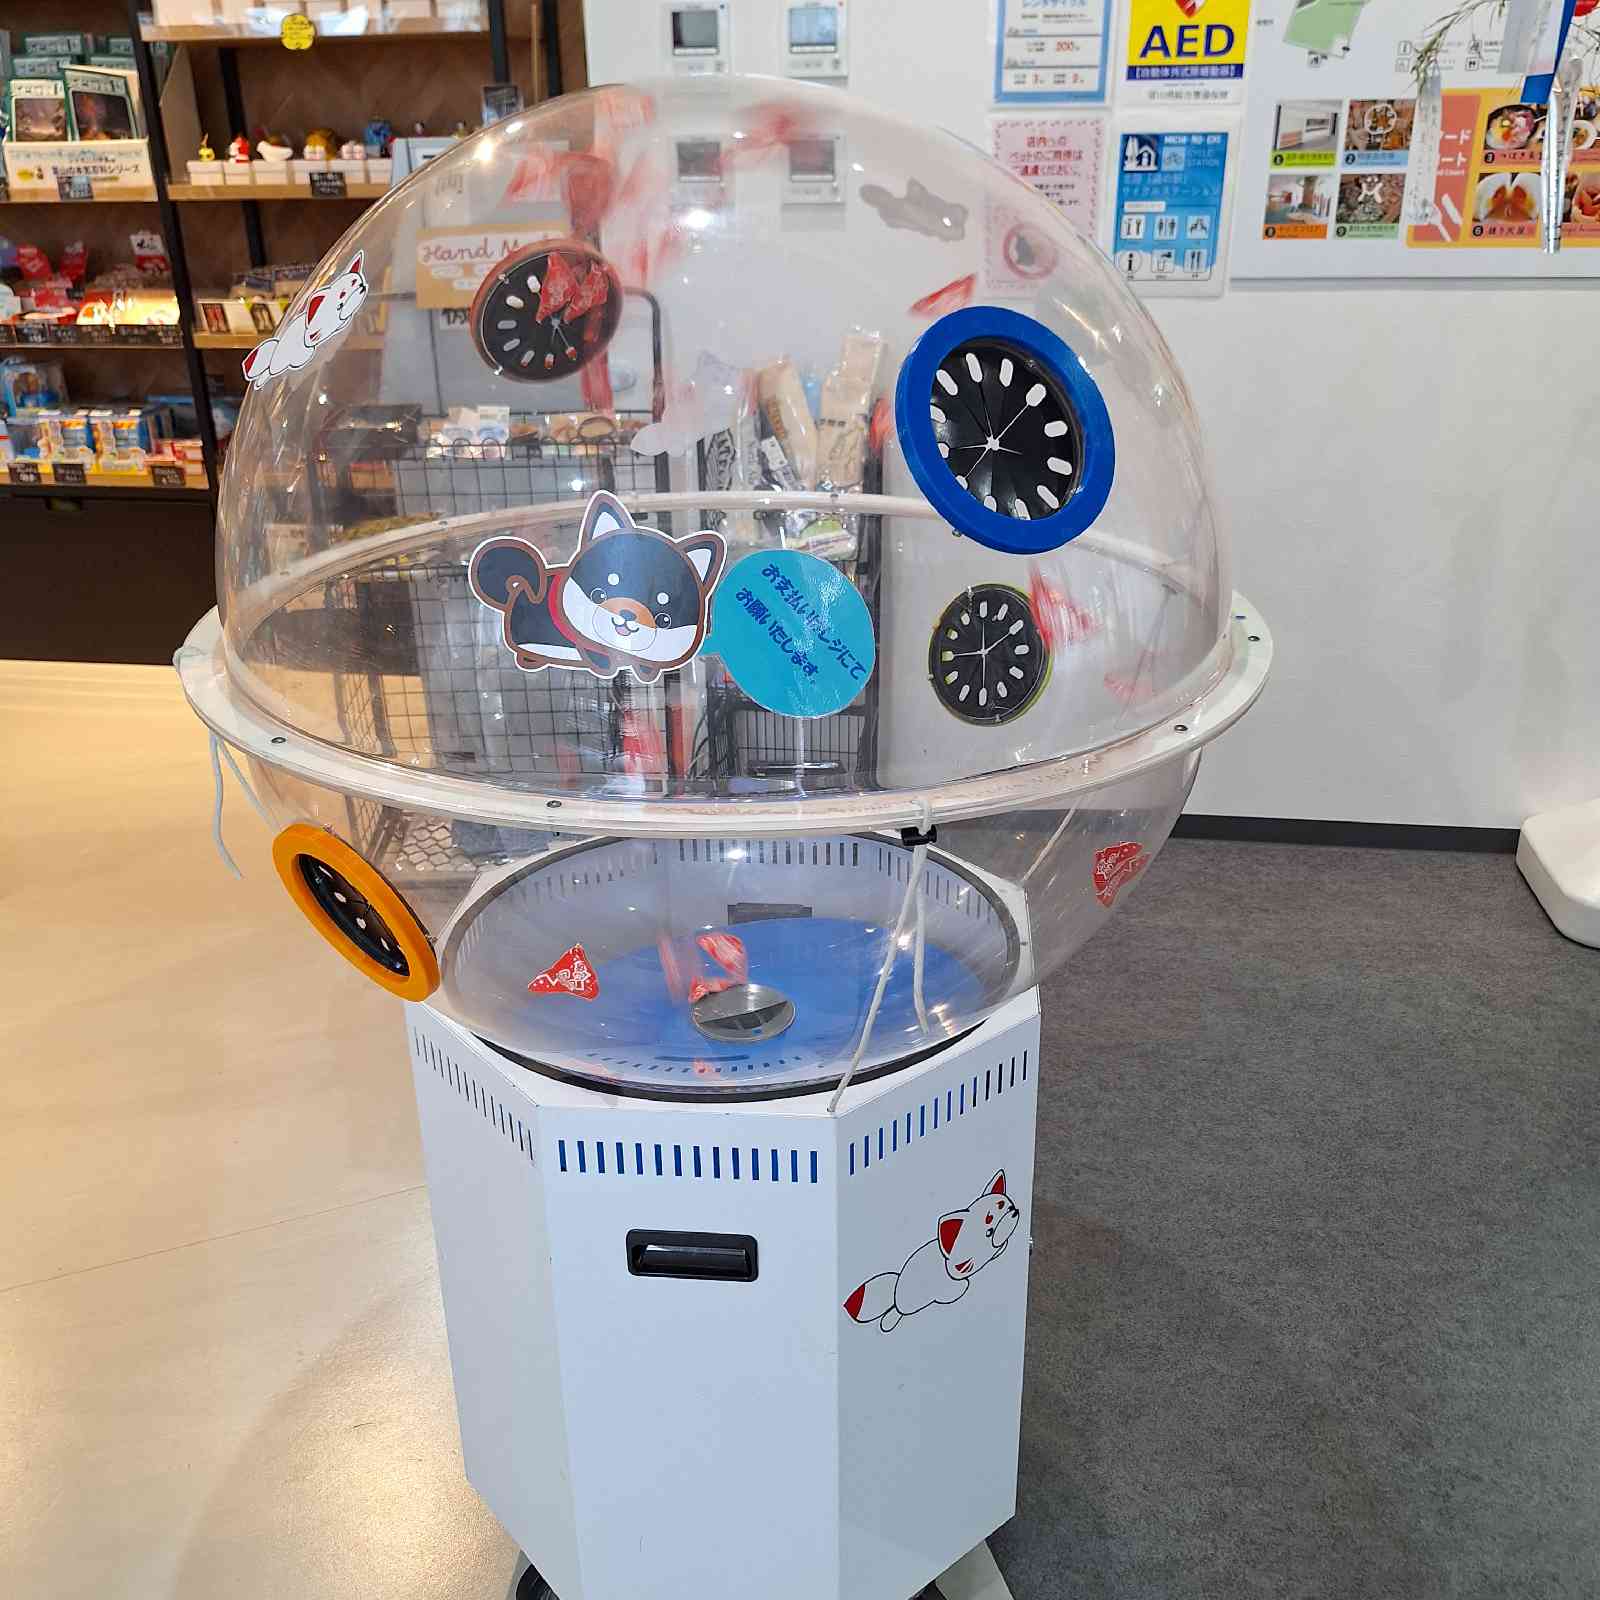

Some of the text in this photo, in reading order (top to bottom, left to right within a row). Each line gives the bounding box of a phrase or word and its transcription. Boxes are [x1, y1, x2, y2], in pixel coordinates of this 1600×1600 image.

[1139, 24, 1235, 58] AED
[1440, 128, 1472, 144] ード
[422, 237, 494, 263] Hand
